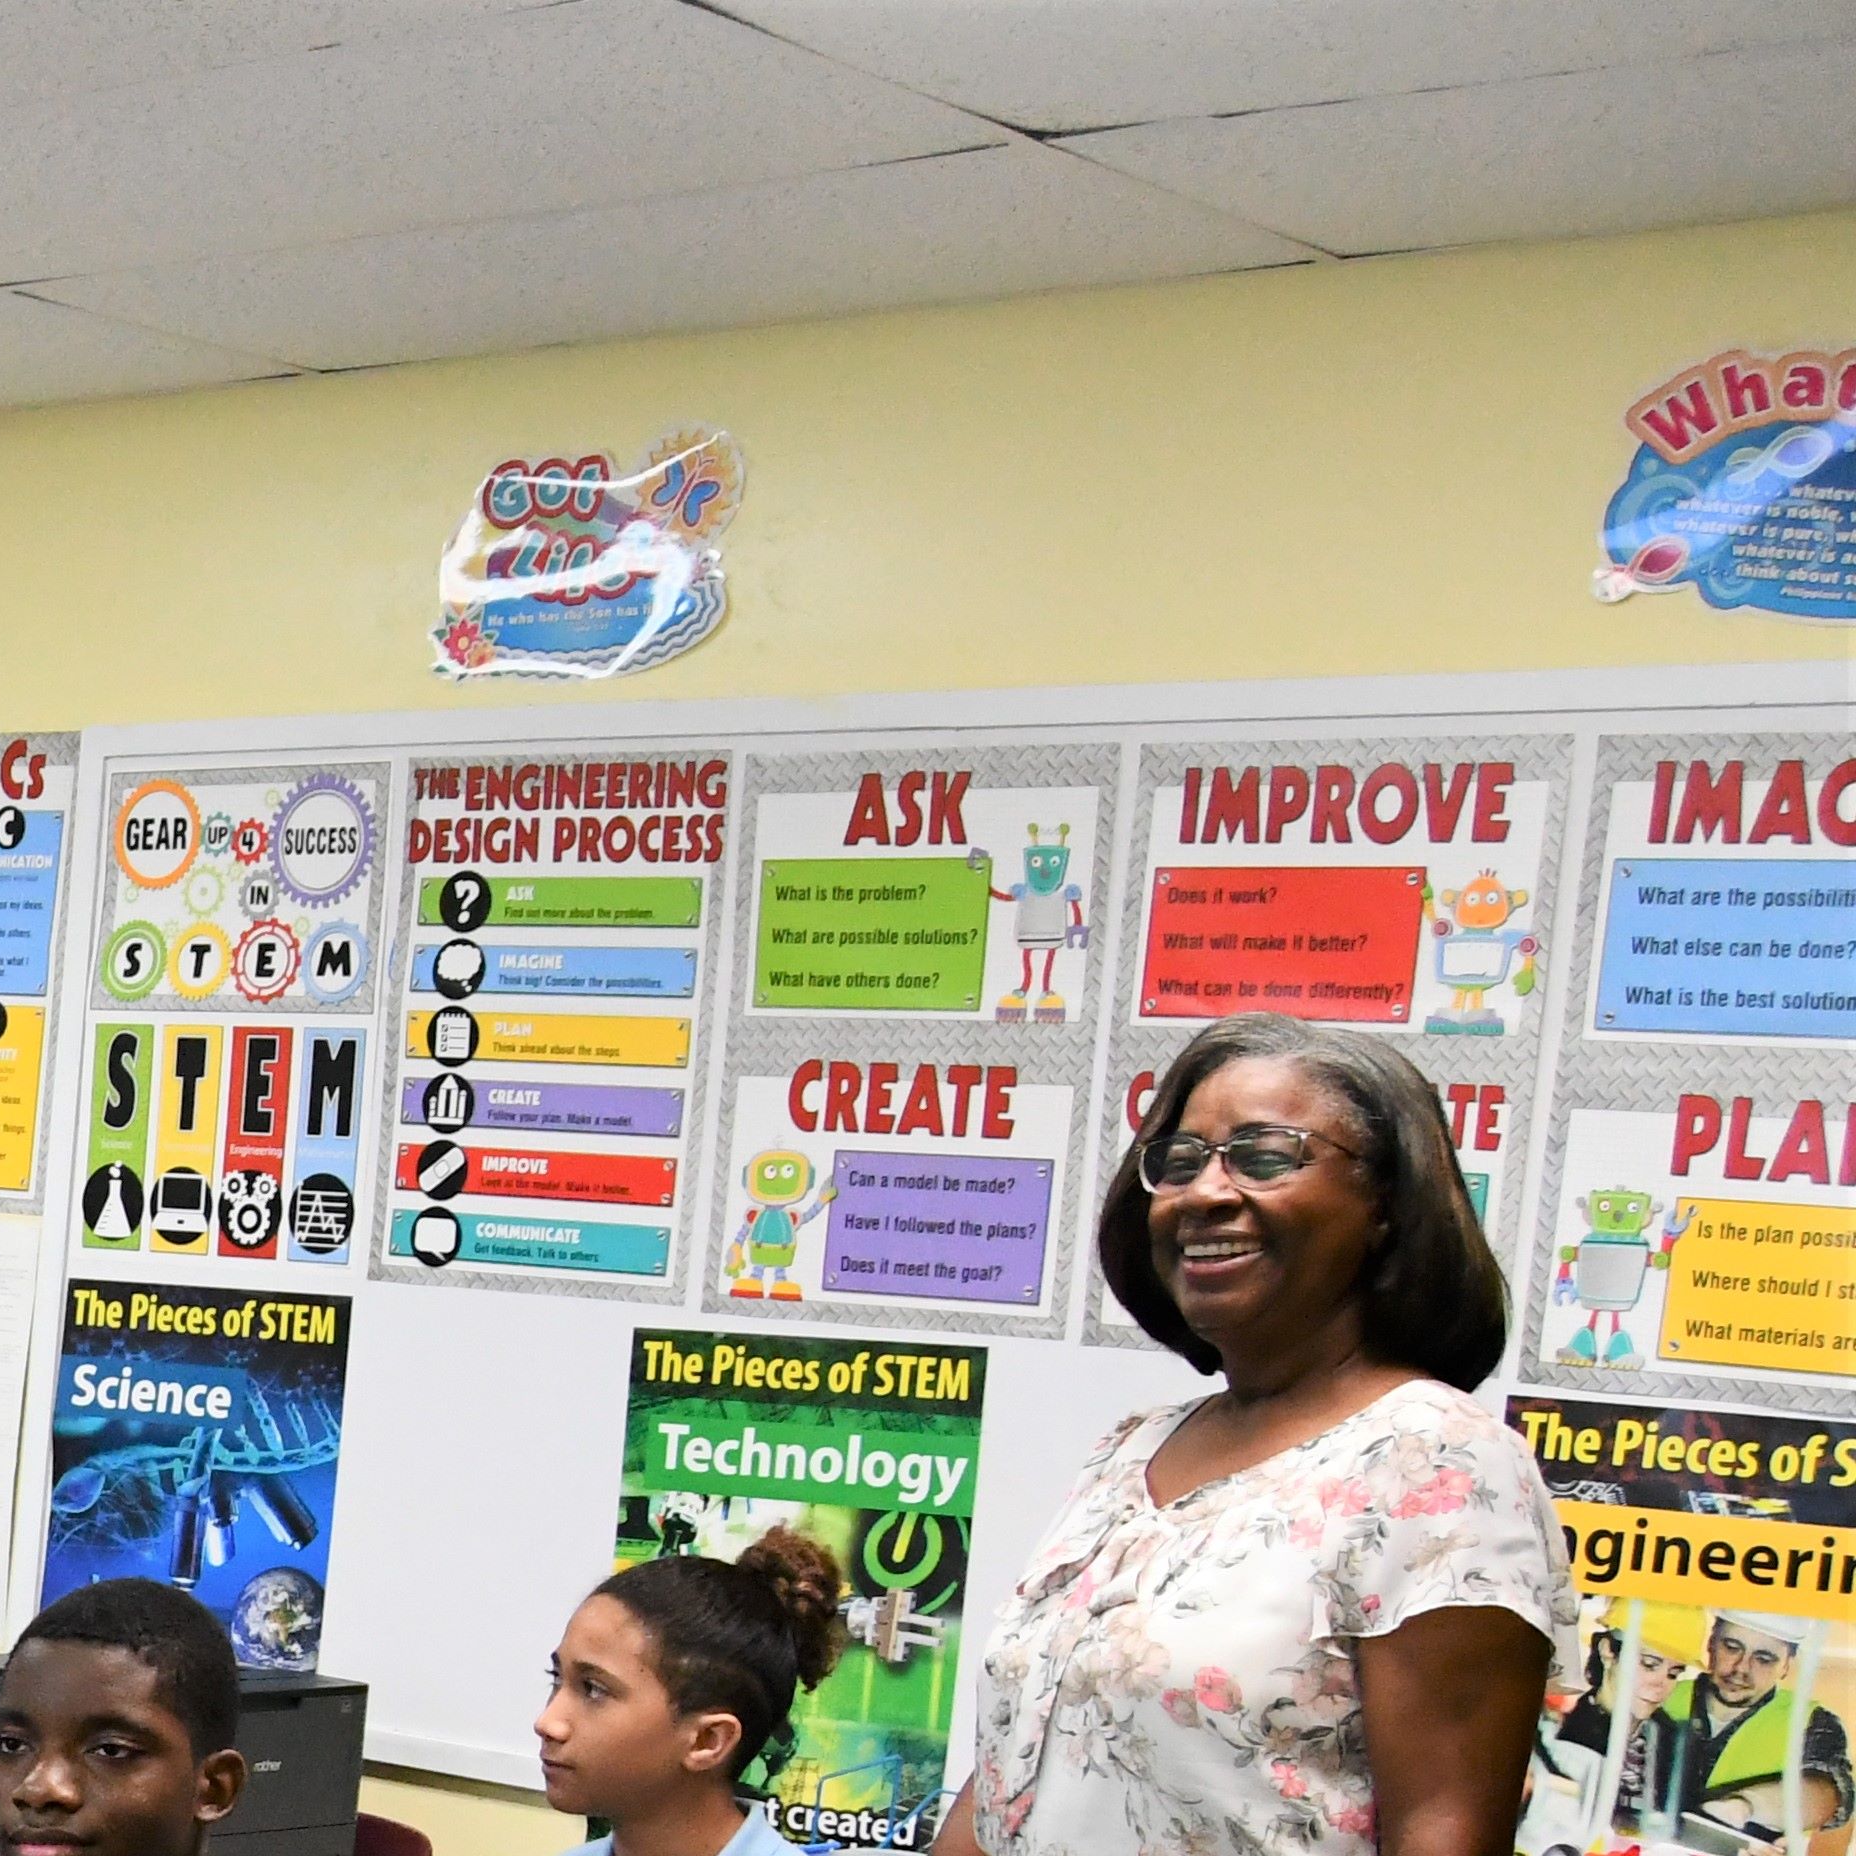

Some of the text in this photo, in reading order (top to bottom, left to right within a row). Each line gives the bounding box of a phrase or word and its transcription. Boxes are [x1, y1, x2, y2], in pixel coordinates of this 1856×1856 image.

[0, 739, 47, 800] Cs
[414, 760, 728, 811] THE ENGINEERING
[842, 770, 972, 848] ASK
[1179, 762, 1516, 845] IMPROVE
[125, 817, 228, 851] GEAR UP
[241, 831, 255, 852] 4
[284, 826, 357, 855] SUCCESS
[408, 814, 725, 864] DESIGN PROCESS
[250, 885, 269, 905] IN
[506, 885, 535, 901] ASK
[775, 884, 926, 905] What is the problem?
[771, 928, 978, 948] What are possible solutions?
[1163, 933, 1368, 953] What will make it better?
[1631, 937, 1856, 960] What else can be done?
[499, 954, 564, 970] IMAGINE
[769, 971, 940, 990] What have others done?
[1158, 979, 1405, 1005] What can be done differently?
[1625, 986, 1672, 1006] What
[1678, 988, 1693, 1006] is
[1700, 988, 1728, 1007] the
[1734, 989, 1774, 1008] best
[494, 1021, 532, 1037] PLAN
[488, 1089, 541, 1107] CREATE
[788, 1058, 1018, 1140] CREATE
[229, 1144, 283, 1158] Engineering
[482, 1155, 549, 1176] IMPROVE
[849, 1171, 1016, 1195] Can a model be made?
[475, 1222, 581, 1245] COMMUNICATE
[840, 1256, 1003, 1283] Does it meet the goal?
[73, 1289, 335, 1345] The Pieces of STEM
[643, 1340, 971, 1402] The Pieces of STEM
[70, 1363, 233, 1420] Science
[1521, 1411, 1602, 1465] The
[1612, 1418, 1760, 1479] Pieces
[1769, 1433, 1829, 1484] of
[657, 1422, 969, 1507] Technology
[787, 1805, 918, 1847] created
